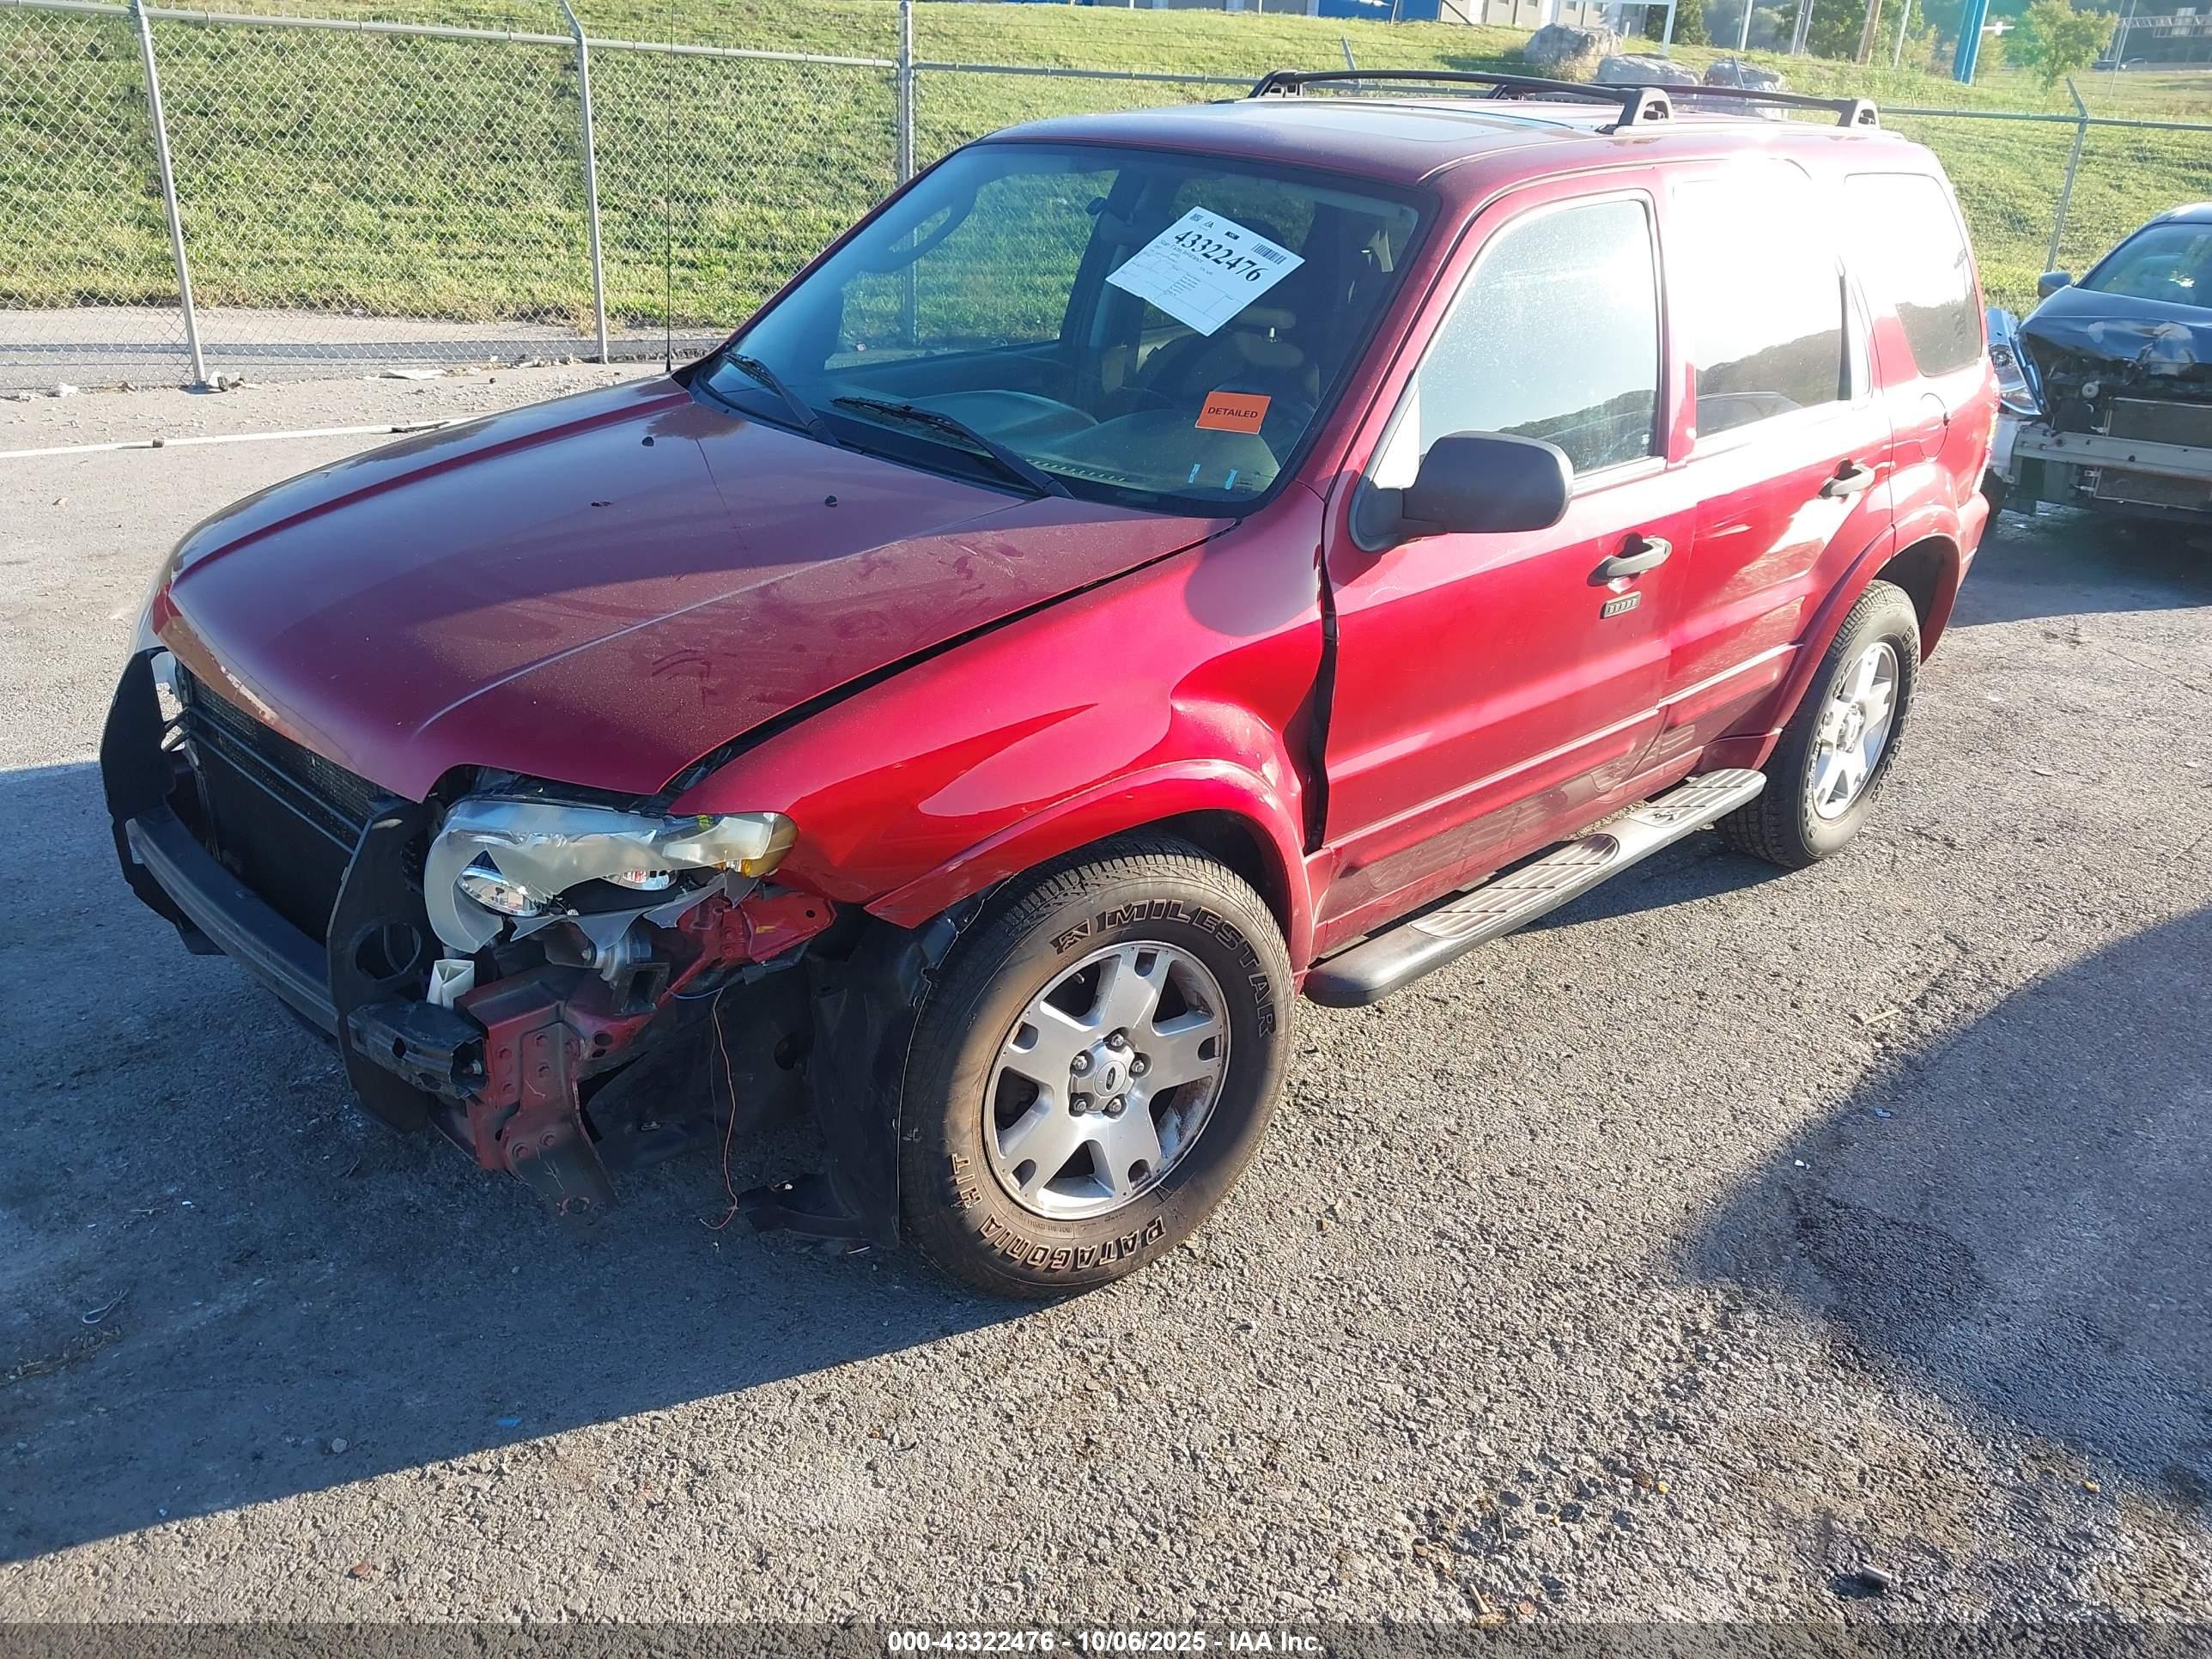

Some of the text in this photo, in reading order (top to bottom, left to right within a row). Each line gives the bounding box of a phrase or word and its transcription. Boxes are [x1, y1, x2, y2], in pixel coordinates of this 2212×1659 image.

[1175, 230, 1270, 282] 43322476
[1207, 407, 1258, 418] DETAILED
[1104, 900, 1277, 1038] MILESTAR
[983, 1212, 1166, 1269] PATAGONIA
